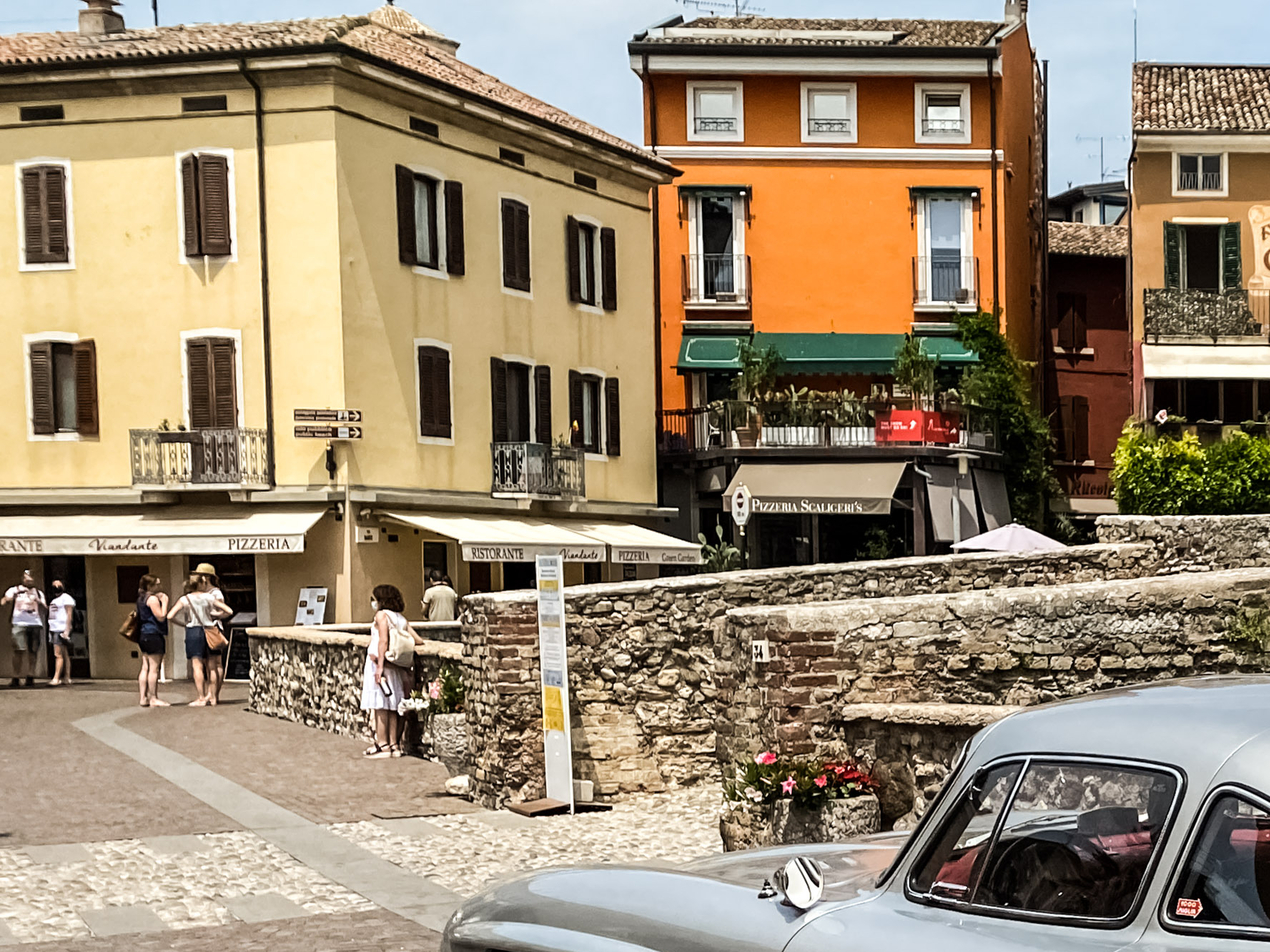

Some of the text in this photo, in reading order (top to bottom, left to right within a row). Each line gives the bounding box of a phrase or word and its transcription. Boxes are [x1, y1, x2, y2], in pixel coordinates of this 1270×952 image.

[752, 498, 798, 512] PIZZERIA
[88, 538, 159, 551] Viandante
[228, 538, 291, 551] PIZZERIA
[471, 548, 599, 560] RISTORANTE Viandante
[619, 550, 650, 562] PIZZERIA
[1180, 900, 1197, 908] 1000
